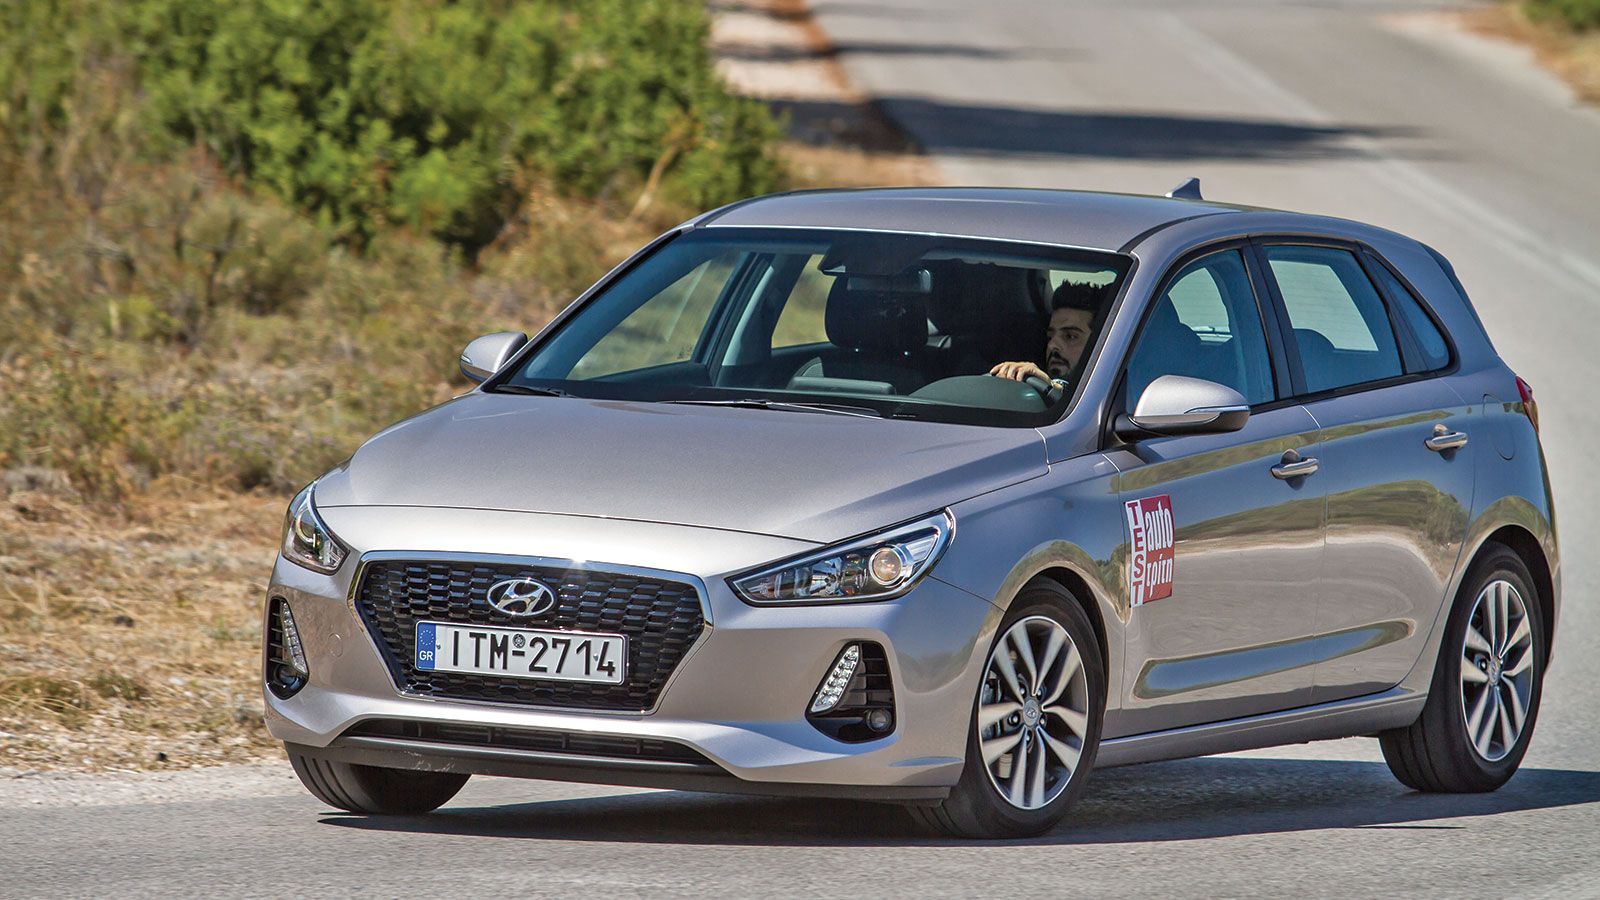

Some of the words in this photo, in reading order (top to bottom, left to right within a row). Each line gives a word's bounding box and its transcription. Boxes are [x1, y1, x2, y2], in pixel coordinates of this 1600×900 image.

[1145, 500, 1174, 552] auto
[1127, 501, 1144, 605] TEST
[418, 650, 434, 662] GR
